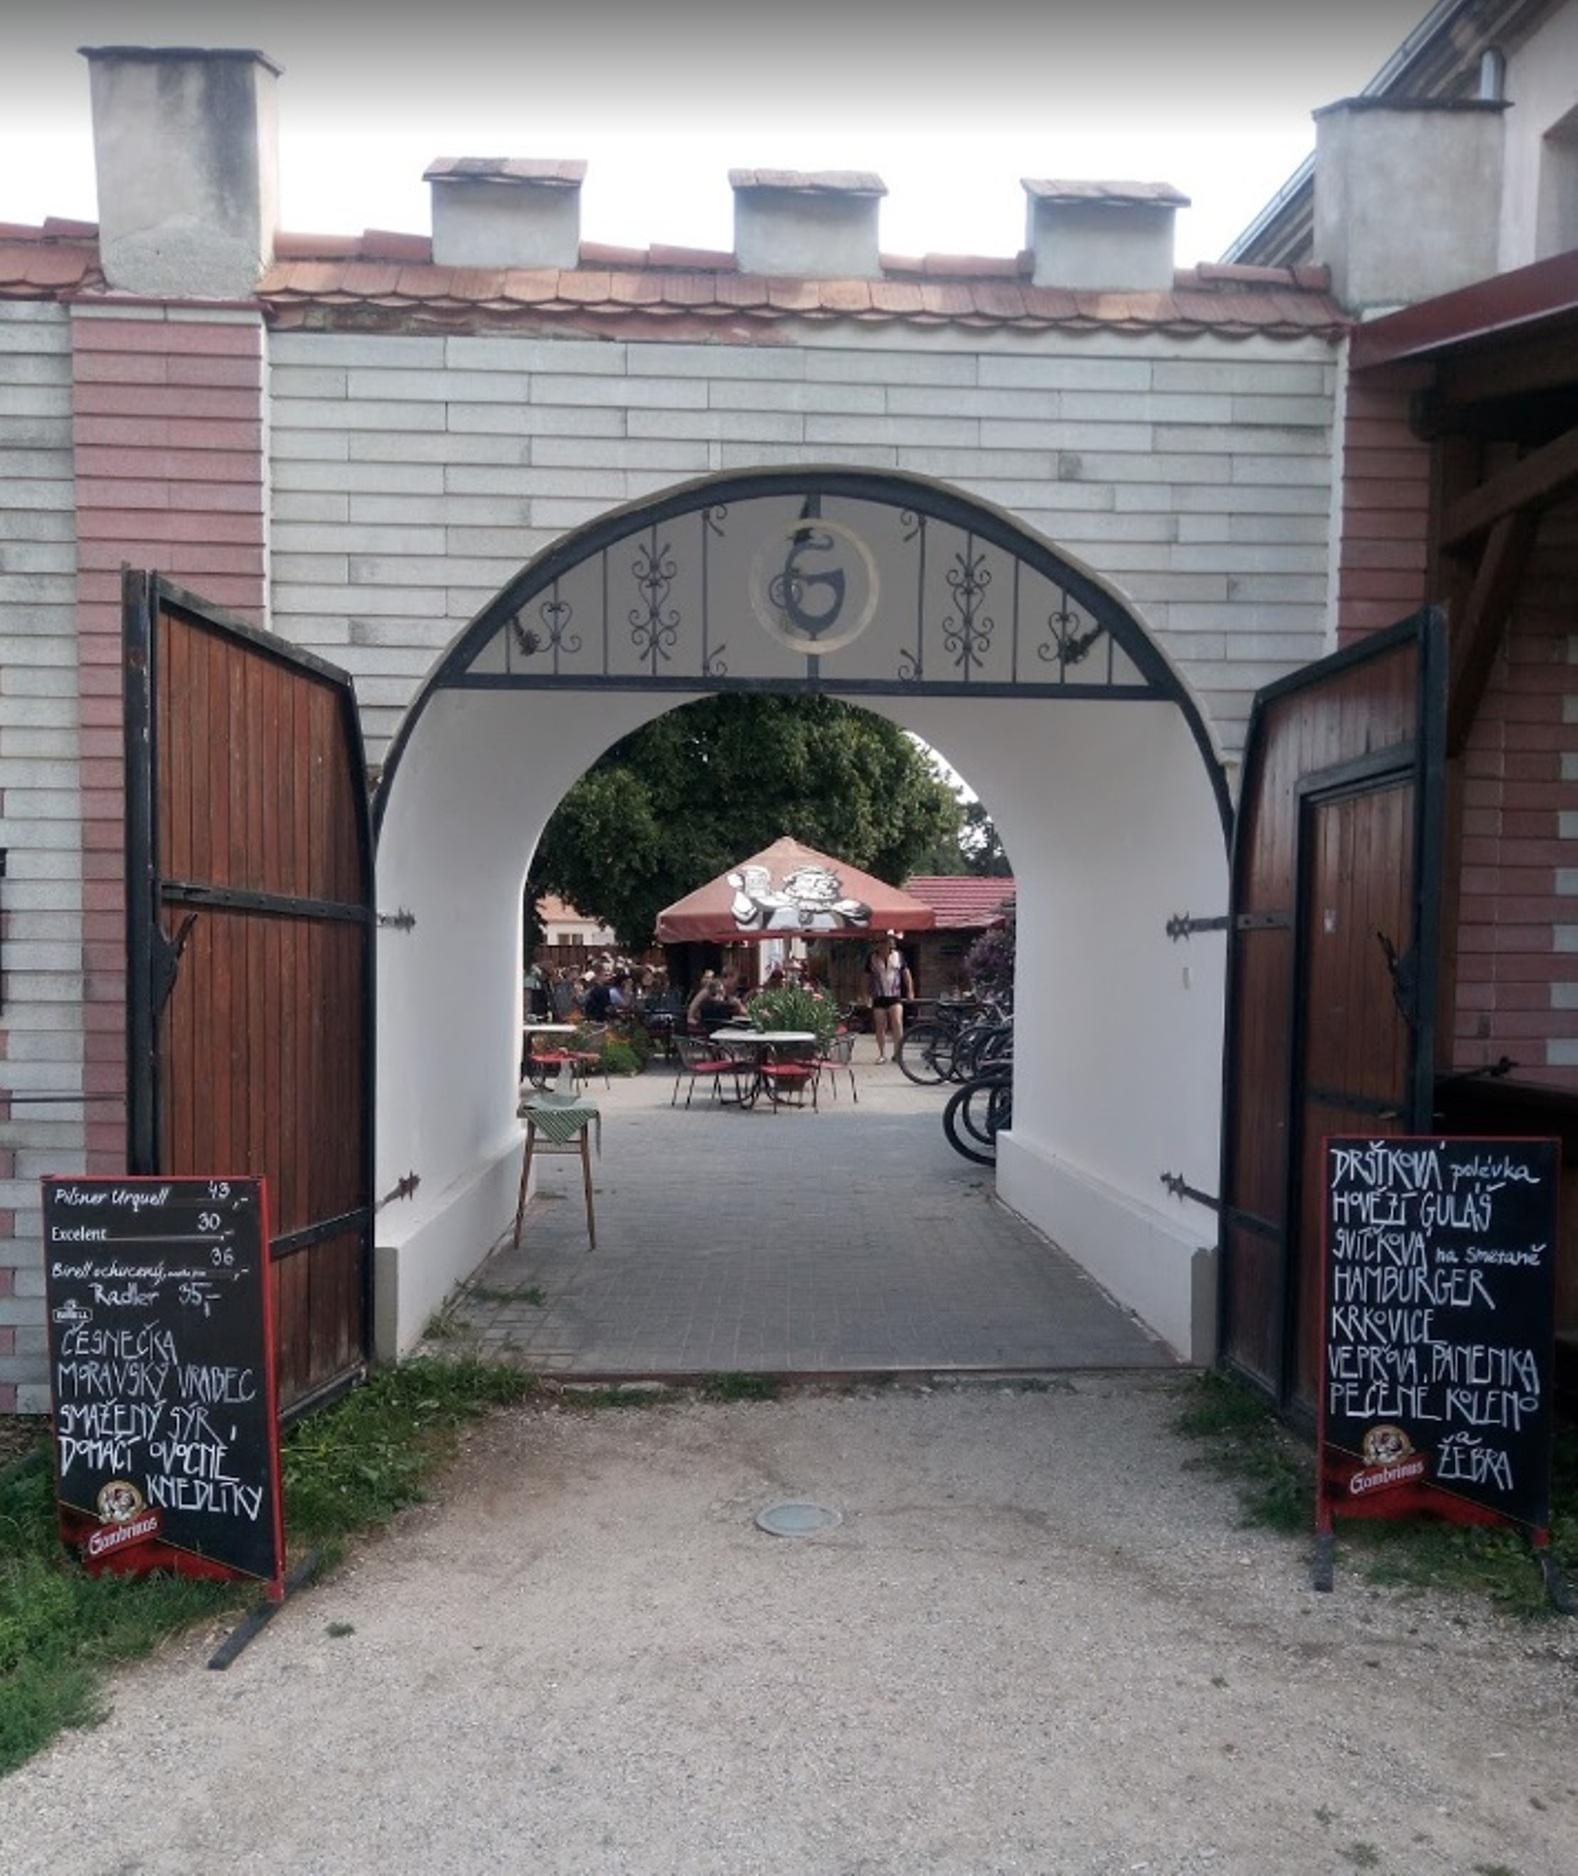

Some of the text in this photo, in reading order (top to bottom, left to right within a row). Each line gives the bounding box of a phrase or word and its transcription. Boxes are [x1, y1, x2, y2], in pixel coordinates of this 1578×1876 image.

[1449, 1154, 1541, 1193] polévka
[54, 1187, 107, 1205] Pilsner
[111, 1186, 170, 1212] Urquell
[1435, 1247, 1459, 1264] na
[88, 1282, 160, 1307] Radler
[1334, 1265, 1496, 1311] HAMBURGER
[1332, 1306, 1449, 1345] KRKOVICE
[177, 1364, 257, 1404] VRABEC
[1446, 1387, 1540, 1431] KOLENO
[1350, 1460, 1425, 1495] Gambrinus
[88, 1515, 159, 1556] Gambrinus
